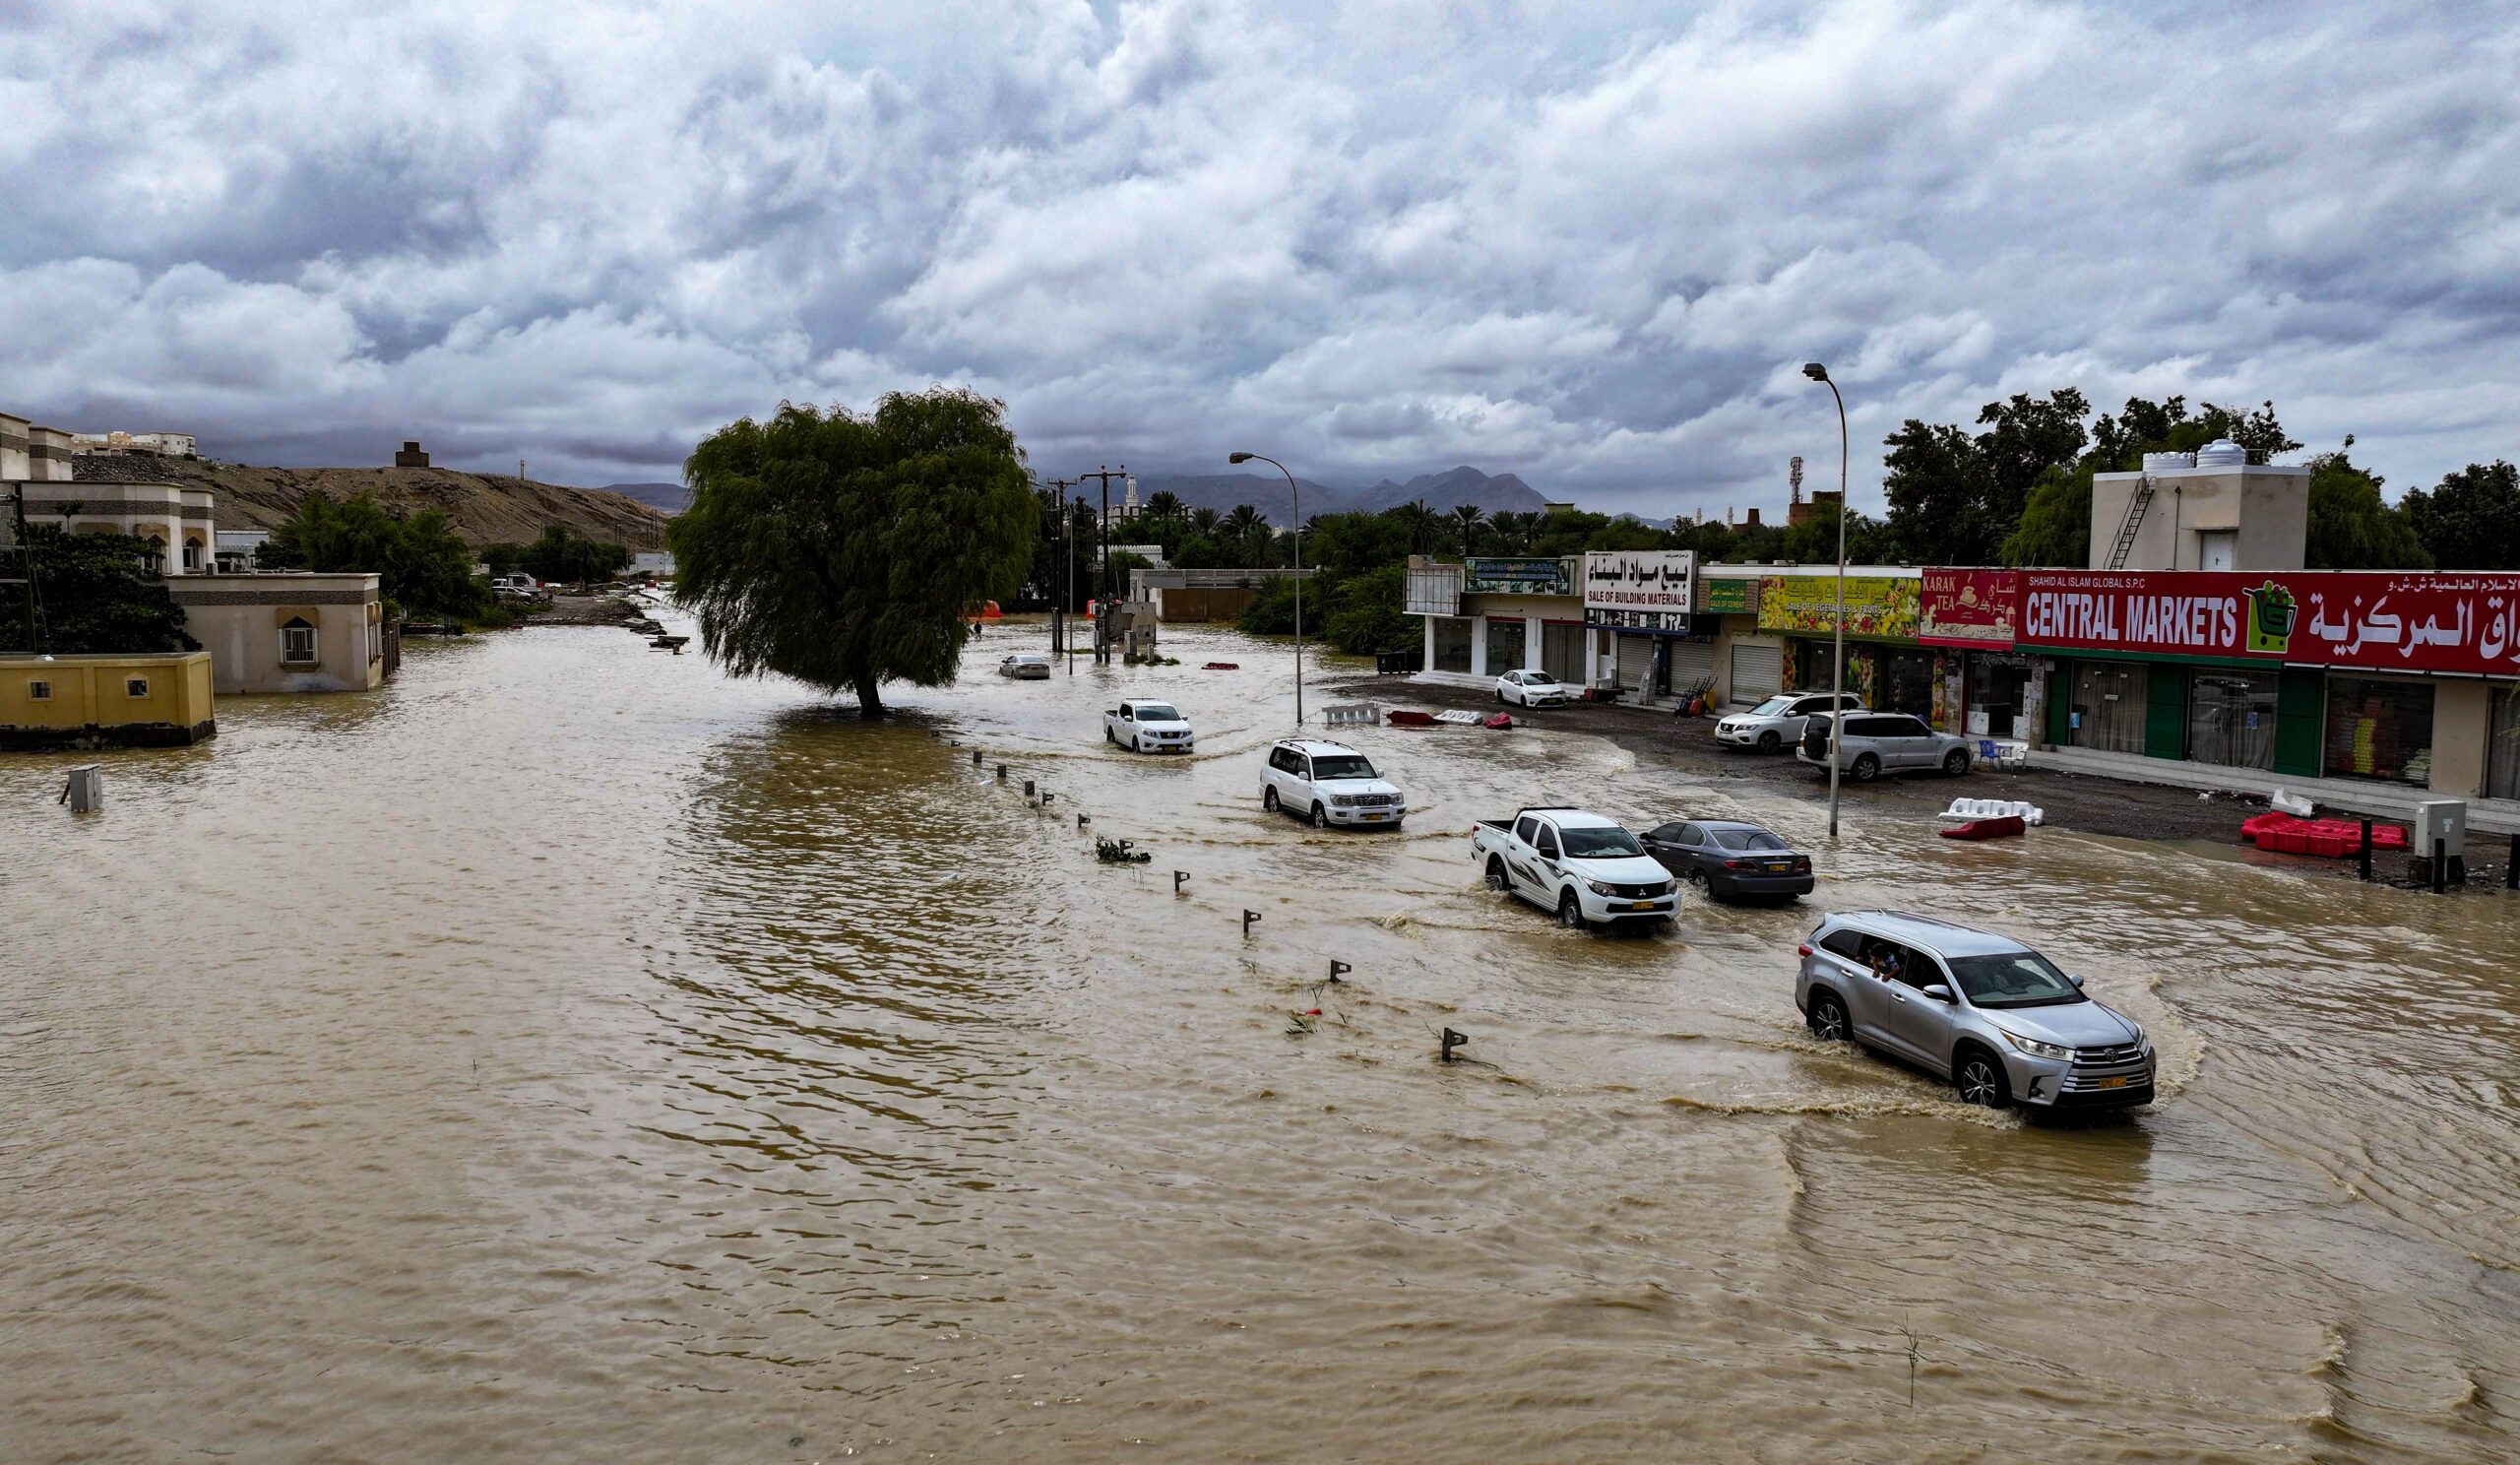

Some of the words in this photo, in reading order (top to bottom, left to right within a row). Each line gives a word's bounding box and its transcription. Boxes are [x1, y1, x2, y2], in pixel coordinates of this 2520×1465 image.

[1588, 557, 1627, 587] البناء
[1629, 557, 1659, 588] مواد
[1661, 564, 1688, 591] بيع
[1922, 576, 1956, 593] KARAK
[1987, 577, 2016, 600] شاي
[2029, 576, 2055, 587] SHAHID
[2057, 577, 2067, 587] AL
[2068, 577, 2091, 588] ISLAM
[2092, 577, 2124, 589] GLOBAL
[2125, 578, 2145, 589] S.P.C
[2429, 578, 2479, 593] العالمية
[1588, 591, 1604, 603] SALE
[1605, 592, 1613, 603] OF
[1614, 591, 1646, 605] BUILDING
[1647, 593, 1687, 605] MATERIALS
[1786, 602, 1801, 610] SALE
[1802, 602, 1811, 611] OF
[1812, 603, 1851, 613] VEGETABES
[1860, 605, 1882, 614] FRUITS
[1936, 595, 1955, 611] TEA
[2026, 592, 2119, 641] CENTRAL
[2125, 595, 2237, 648] MARKETS
[2308, 592, 2474, 659] المركزية
